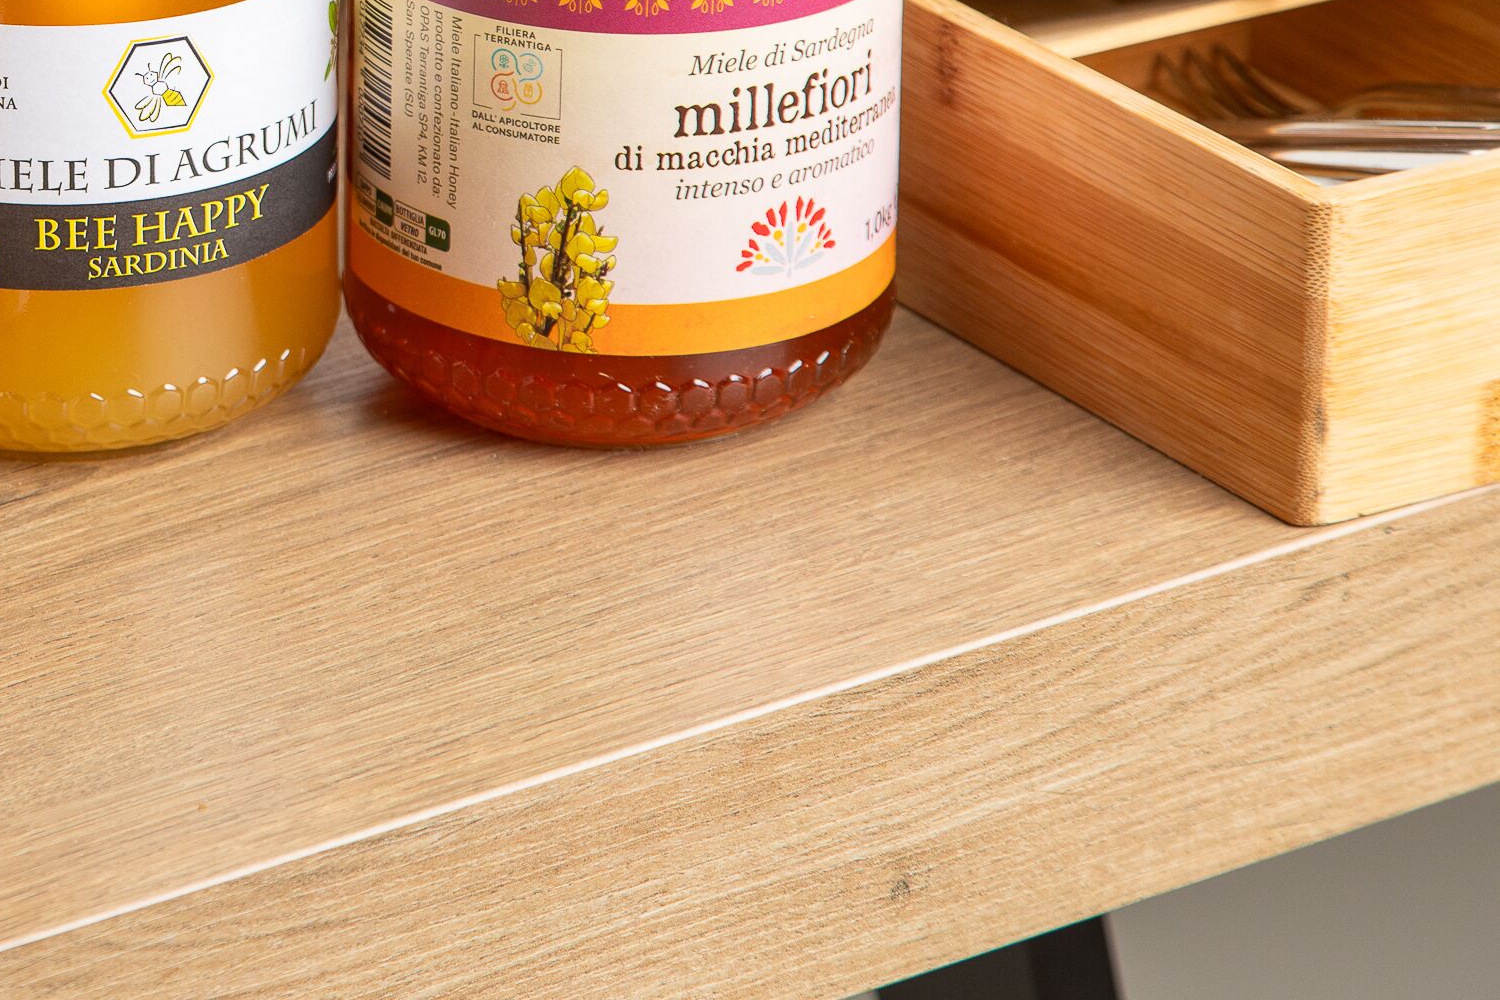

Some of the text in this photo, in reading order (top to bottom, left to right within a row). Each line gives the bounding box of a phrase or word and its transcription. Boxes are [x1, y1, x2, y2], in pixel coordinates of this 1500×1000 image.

[420, 5, 430, 42] OPAS
[434, 10, 445, 71] prodotto
[451, 16, 462, 54] Miele
[484, 32, 552, 52] TERRANTIGA
[496, 25, 536, 40] FILIERA
[403, 0, 415, 118] San Sperate (SU)
[688, 18, 875, 76] Miele di Sardegna
[417, 46, 430, 109] Terrantiga
[674, 49, 873, 138] millefiori
[103, 153, 160, 190] DI
[170, 99, 318, 181] AGRUMI
[433, 86, 444, 174] confezionato
[472, 122, 560, 145] AL CONSUMATORE
[499, 115, 561, 134] APICOLTORE
[418, 144, 428, 166] KM
[614, 145, 643, 171] di
[656, 137, 776, 171] macchia
[676, 136, 875, 201] intenso e aromatico
[432, 177, 443, 198] da:
[446, 165, 460, 209] Honey
[34, 215, 118, 251] BEE
[130, 183, 271, 247] HAPPY
[395, 204, 424, 226] BOTTIGLIA
[428, 226, 446, 240] GL70
[400, 222, 419, 237] VETRO
[88, 238, 229, 281] SARDINIA
